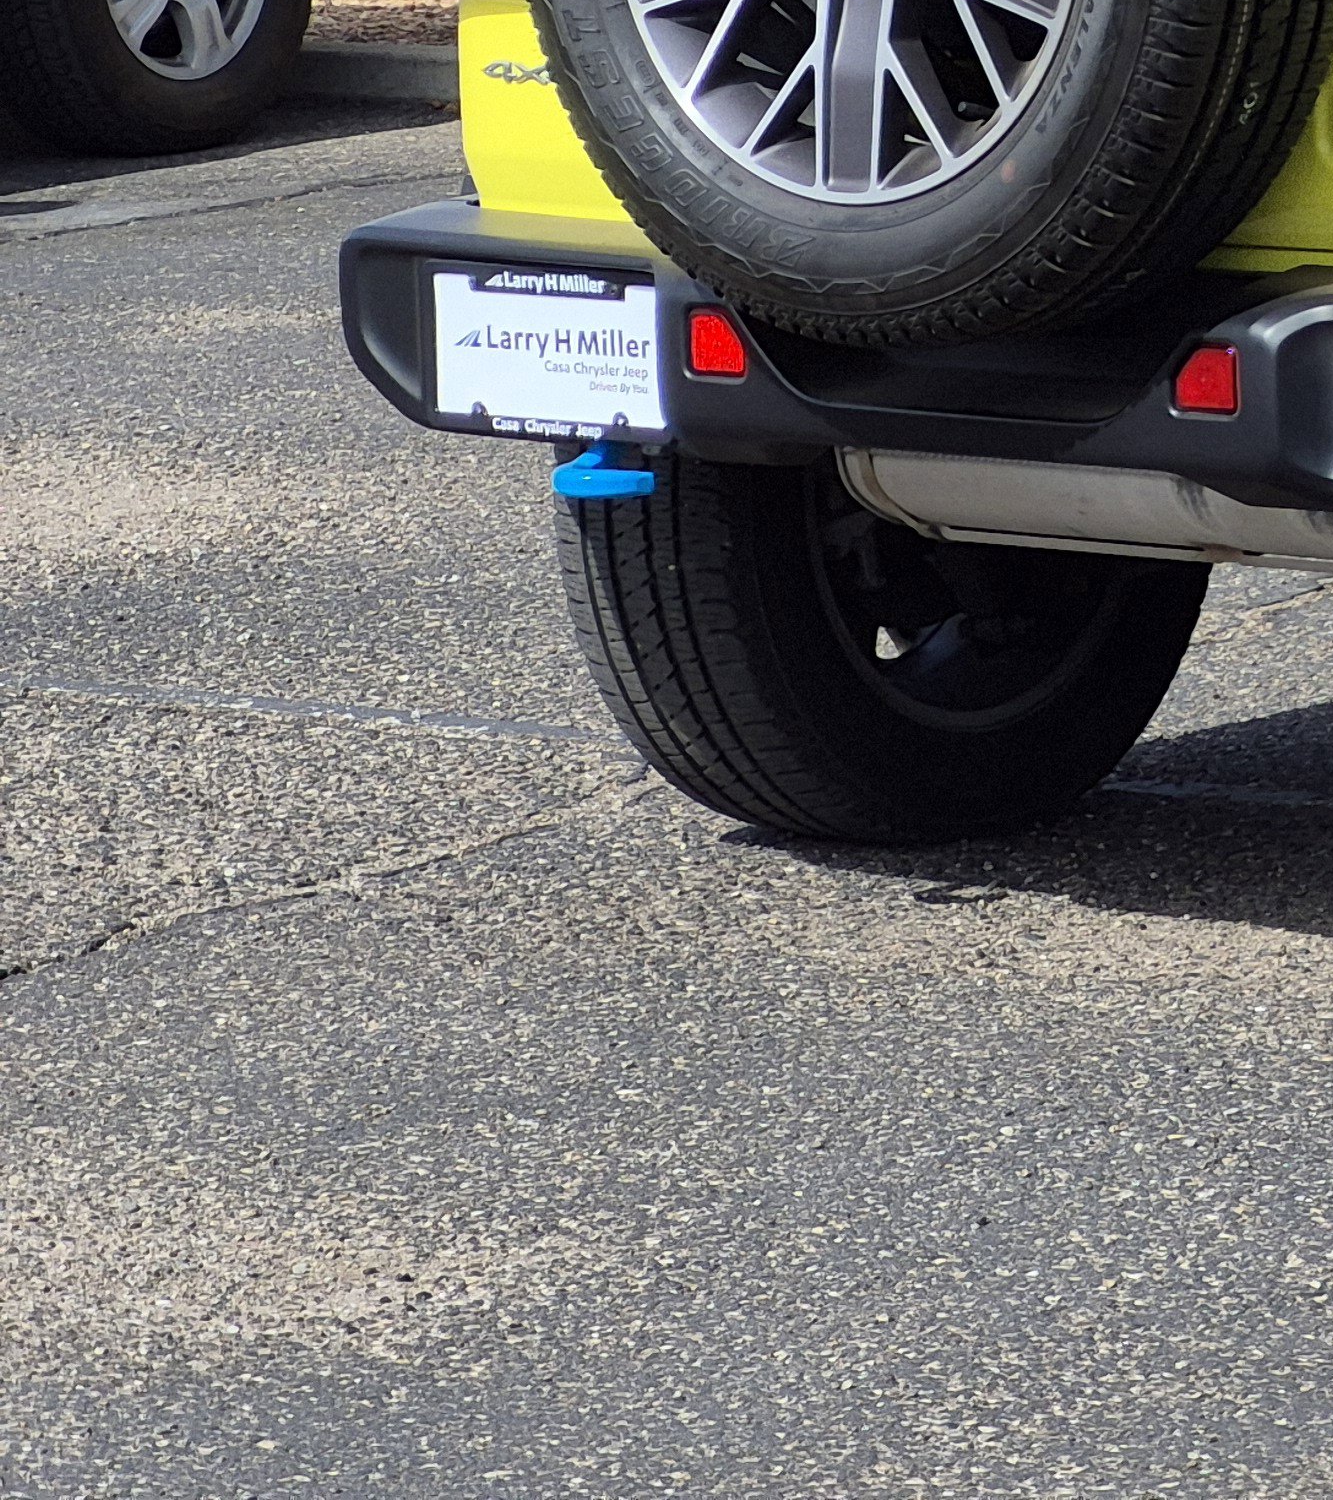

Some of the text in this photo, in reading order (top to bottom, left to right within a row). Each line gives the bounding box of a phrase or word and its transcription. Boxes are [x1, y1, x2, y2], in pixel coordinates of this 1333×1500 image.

[503, 271, 606, 294] Larry H Miller
[486, 324, 650, 359] Larry H Miller
[544, 360, 648, 381] Casa Chrysler Jeep
[492, 417, 603, 440] Casa Chrysler Jeep
